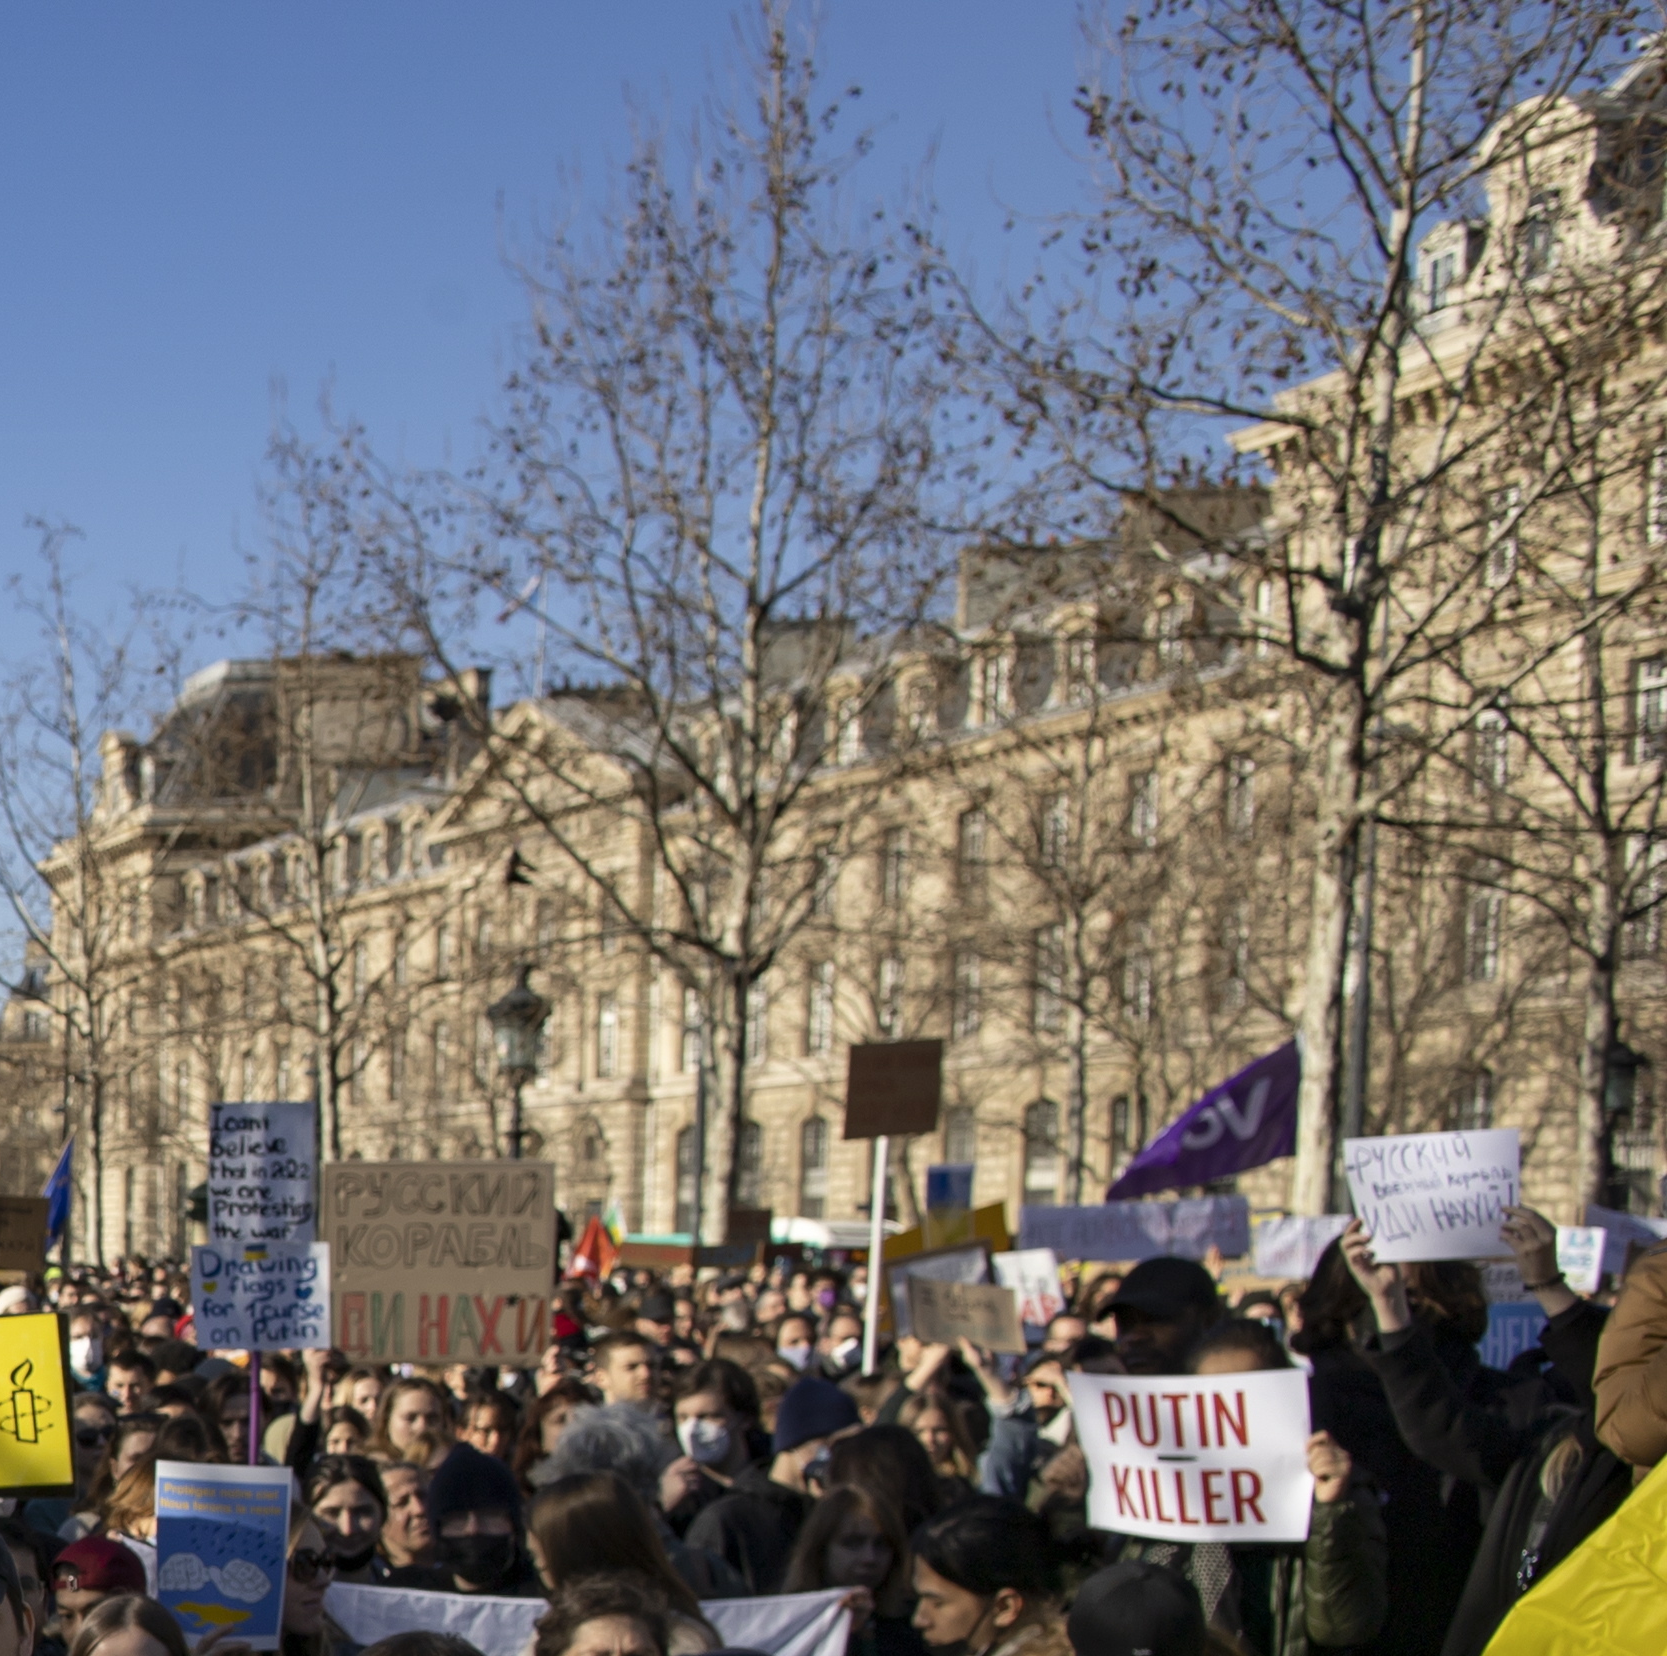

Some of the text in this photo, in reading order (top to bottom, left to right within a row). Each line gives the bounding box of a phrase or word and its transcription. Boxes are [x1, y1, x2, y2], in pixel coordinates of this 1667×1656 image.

[334, 1170, 547, 1220] РУССКИЙ
[1361, 1203, 1427, 1242] ИДИ
[199, 1250, 318, 1284] Drawing
[335, 1221, 550, 1271] КОРАБЛЬ
[203, 1299, 234, 1319] for
[210, 1317, 318, 1344] on Putin
[1103, 1391, 1248, 1449] PUTIN
[1111, 1468, 1266, 1525] KILLER
